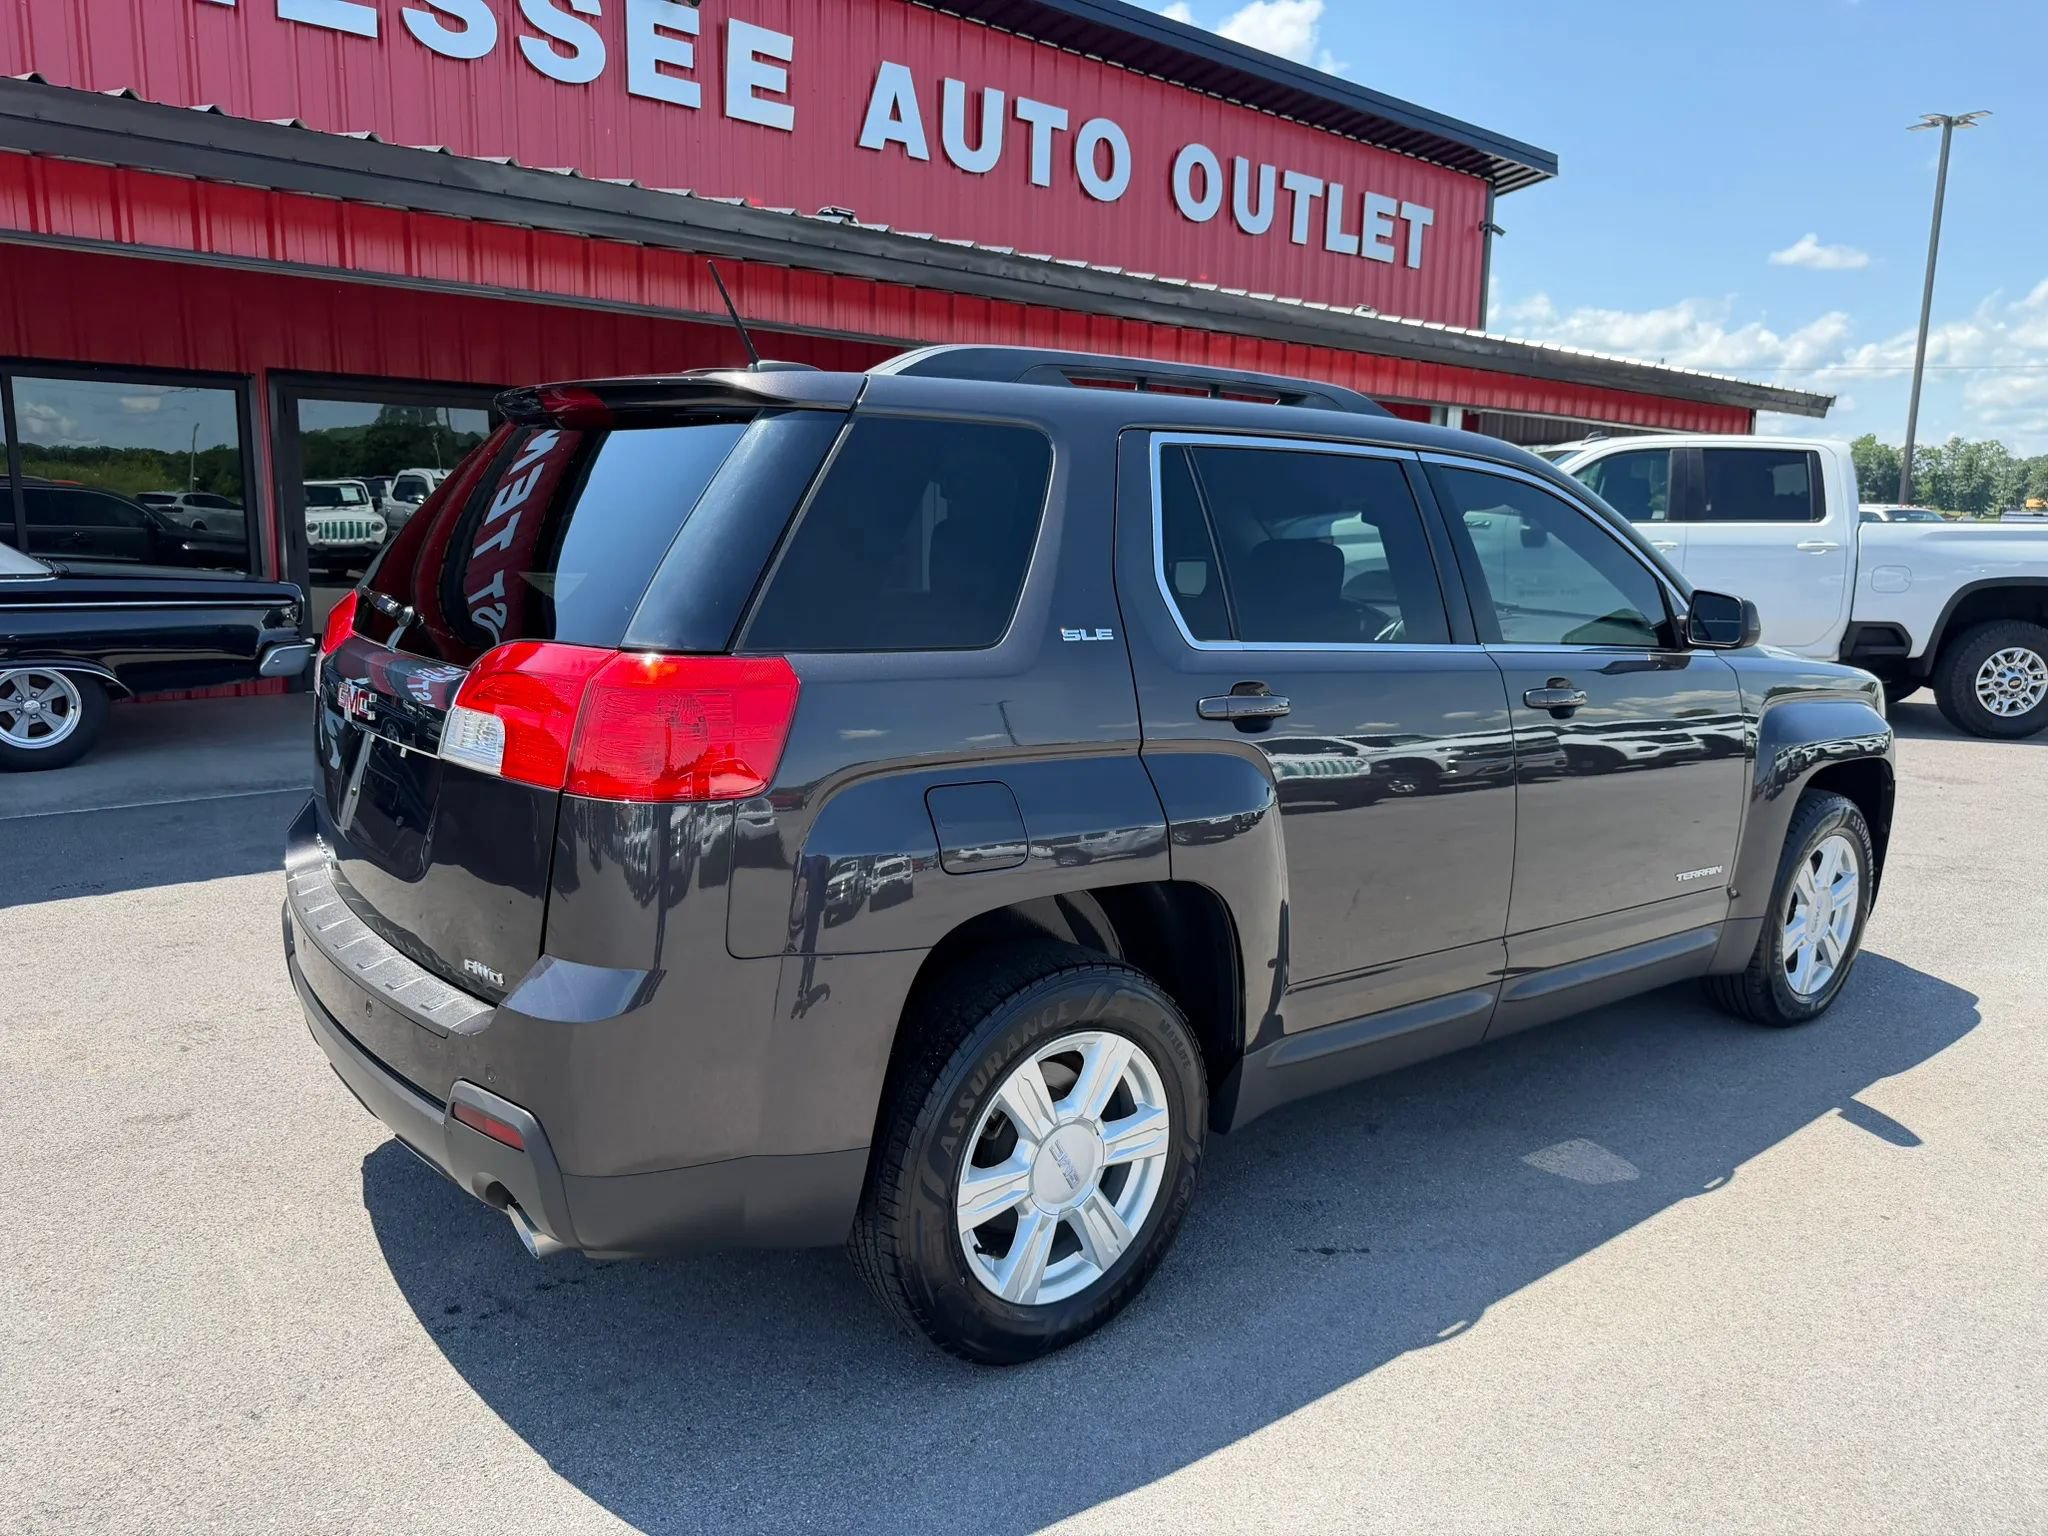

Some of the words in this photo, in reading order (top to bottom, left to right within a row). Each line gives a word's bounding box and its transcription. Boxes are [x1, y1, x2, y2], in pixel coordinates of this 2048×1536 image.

[857, 59, 1132, 202] AUTO
[1172, 142, 1435, 270] OUTLET
[1060, 627, 1115, 642] SLE
[337, 681, 378, 721] GMC
[1675, 865, 1723, 882] TERRAIN
[939, 1001, 1069, 1159] ASSURANCE
[1048, 1139, 1080, 1190] GMC
